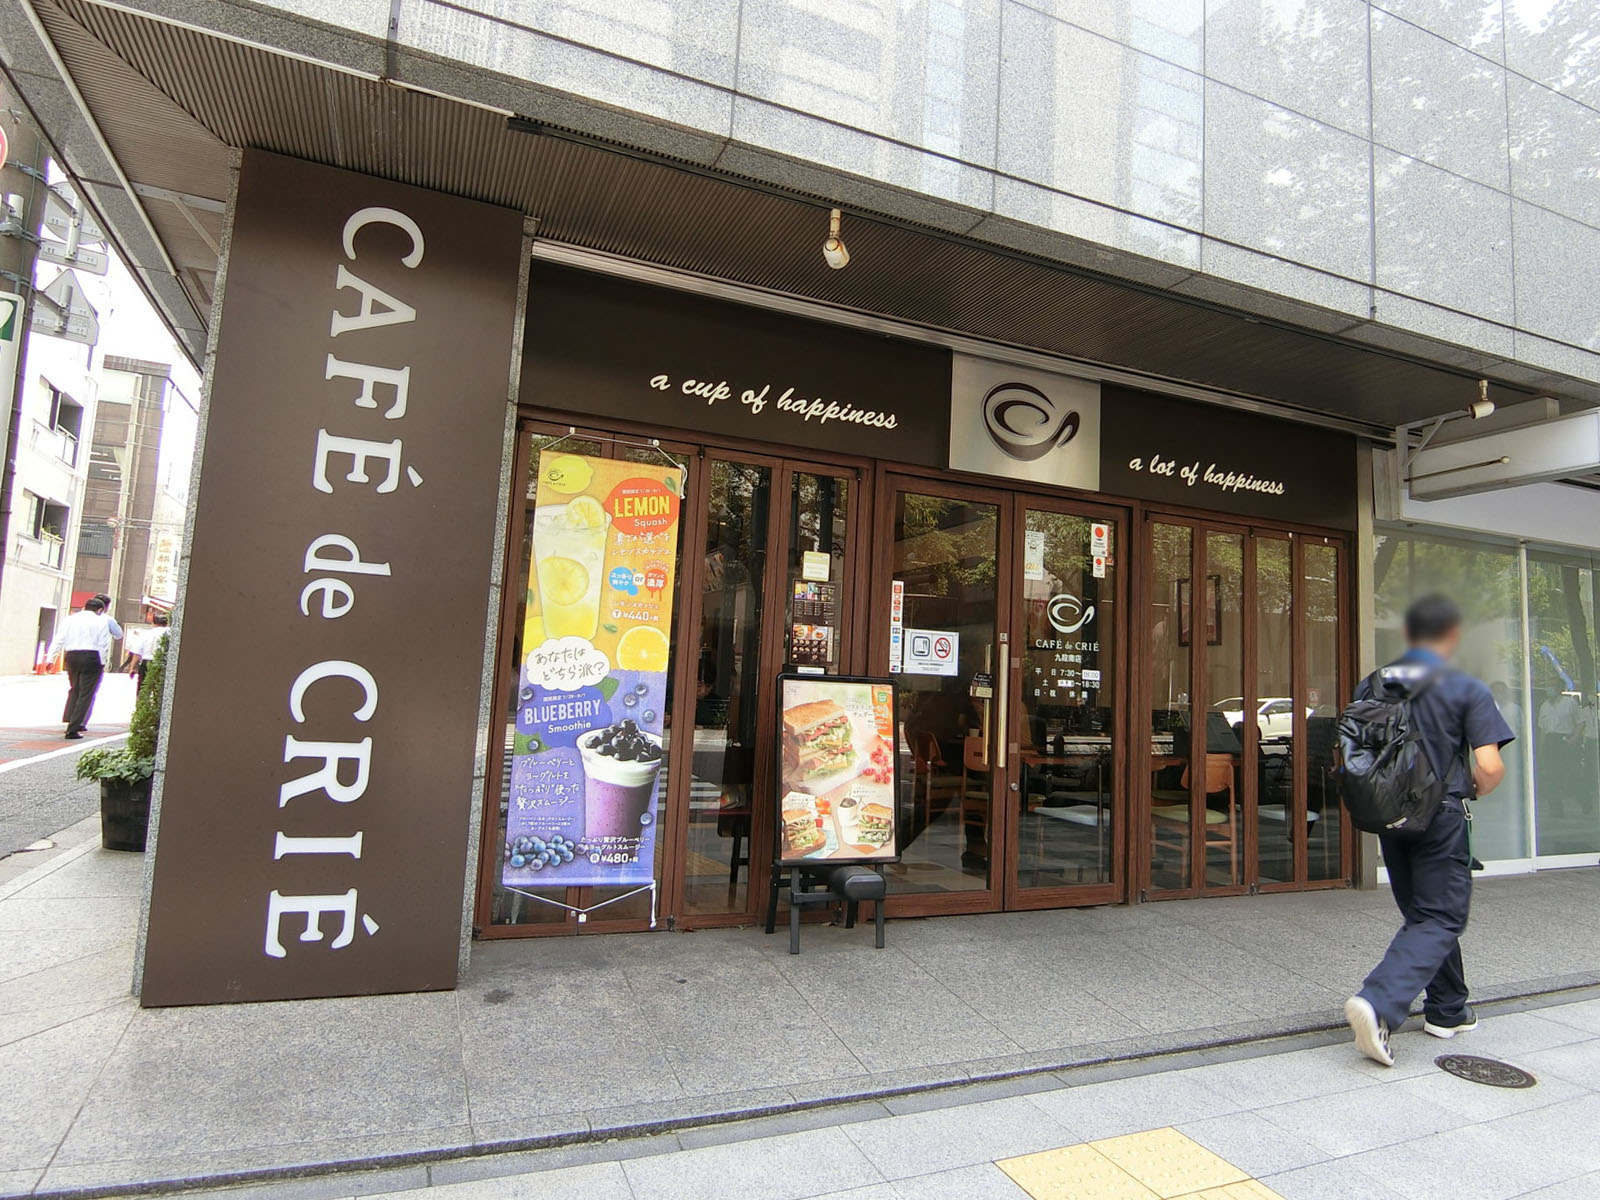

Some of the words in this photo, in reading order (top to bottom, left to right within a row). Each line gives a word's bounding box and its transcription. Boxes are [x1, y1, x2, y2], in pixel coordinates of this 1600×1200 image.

[312, 206, 425, 494] CAFÉ
[649, 374, 672, 391] a
[681, 379, 732, 406] cup
[740, 384, 771, 415] of
[776, 387, 898, 430] happiness
[1128, 457, 1144, 471] a
[1149, 454, 1176, 476] lot
[1180, 461, 1199, 487] of
[1203, 463, 1285, 495] happiness
[614, 495, 670, 518] LEMON
[633, 517, 668, 529] Squash
[300, 533, 392, 619] de
[1035, 638, 1063, 650] CAFÉ
[1064, 641, 1073, 650] de
[1075, 641, 1100, 652] CRIÉ
[534, 647, 587, 666] あなたは
[1042, 679, 1049, 687] 土
[524, 698, 601, 725] BLUEBERRY
[547, 720, 592, 734] Smoothie
[520, 757, 576, 769] ブルーベリーと
[525, 769, 570, 782] ヨーグルトを
[264, 660, 380, 958] CRIÉ
